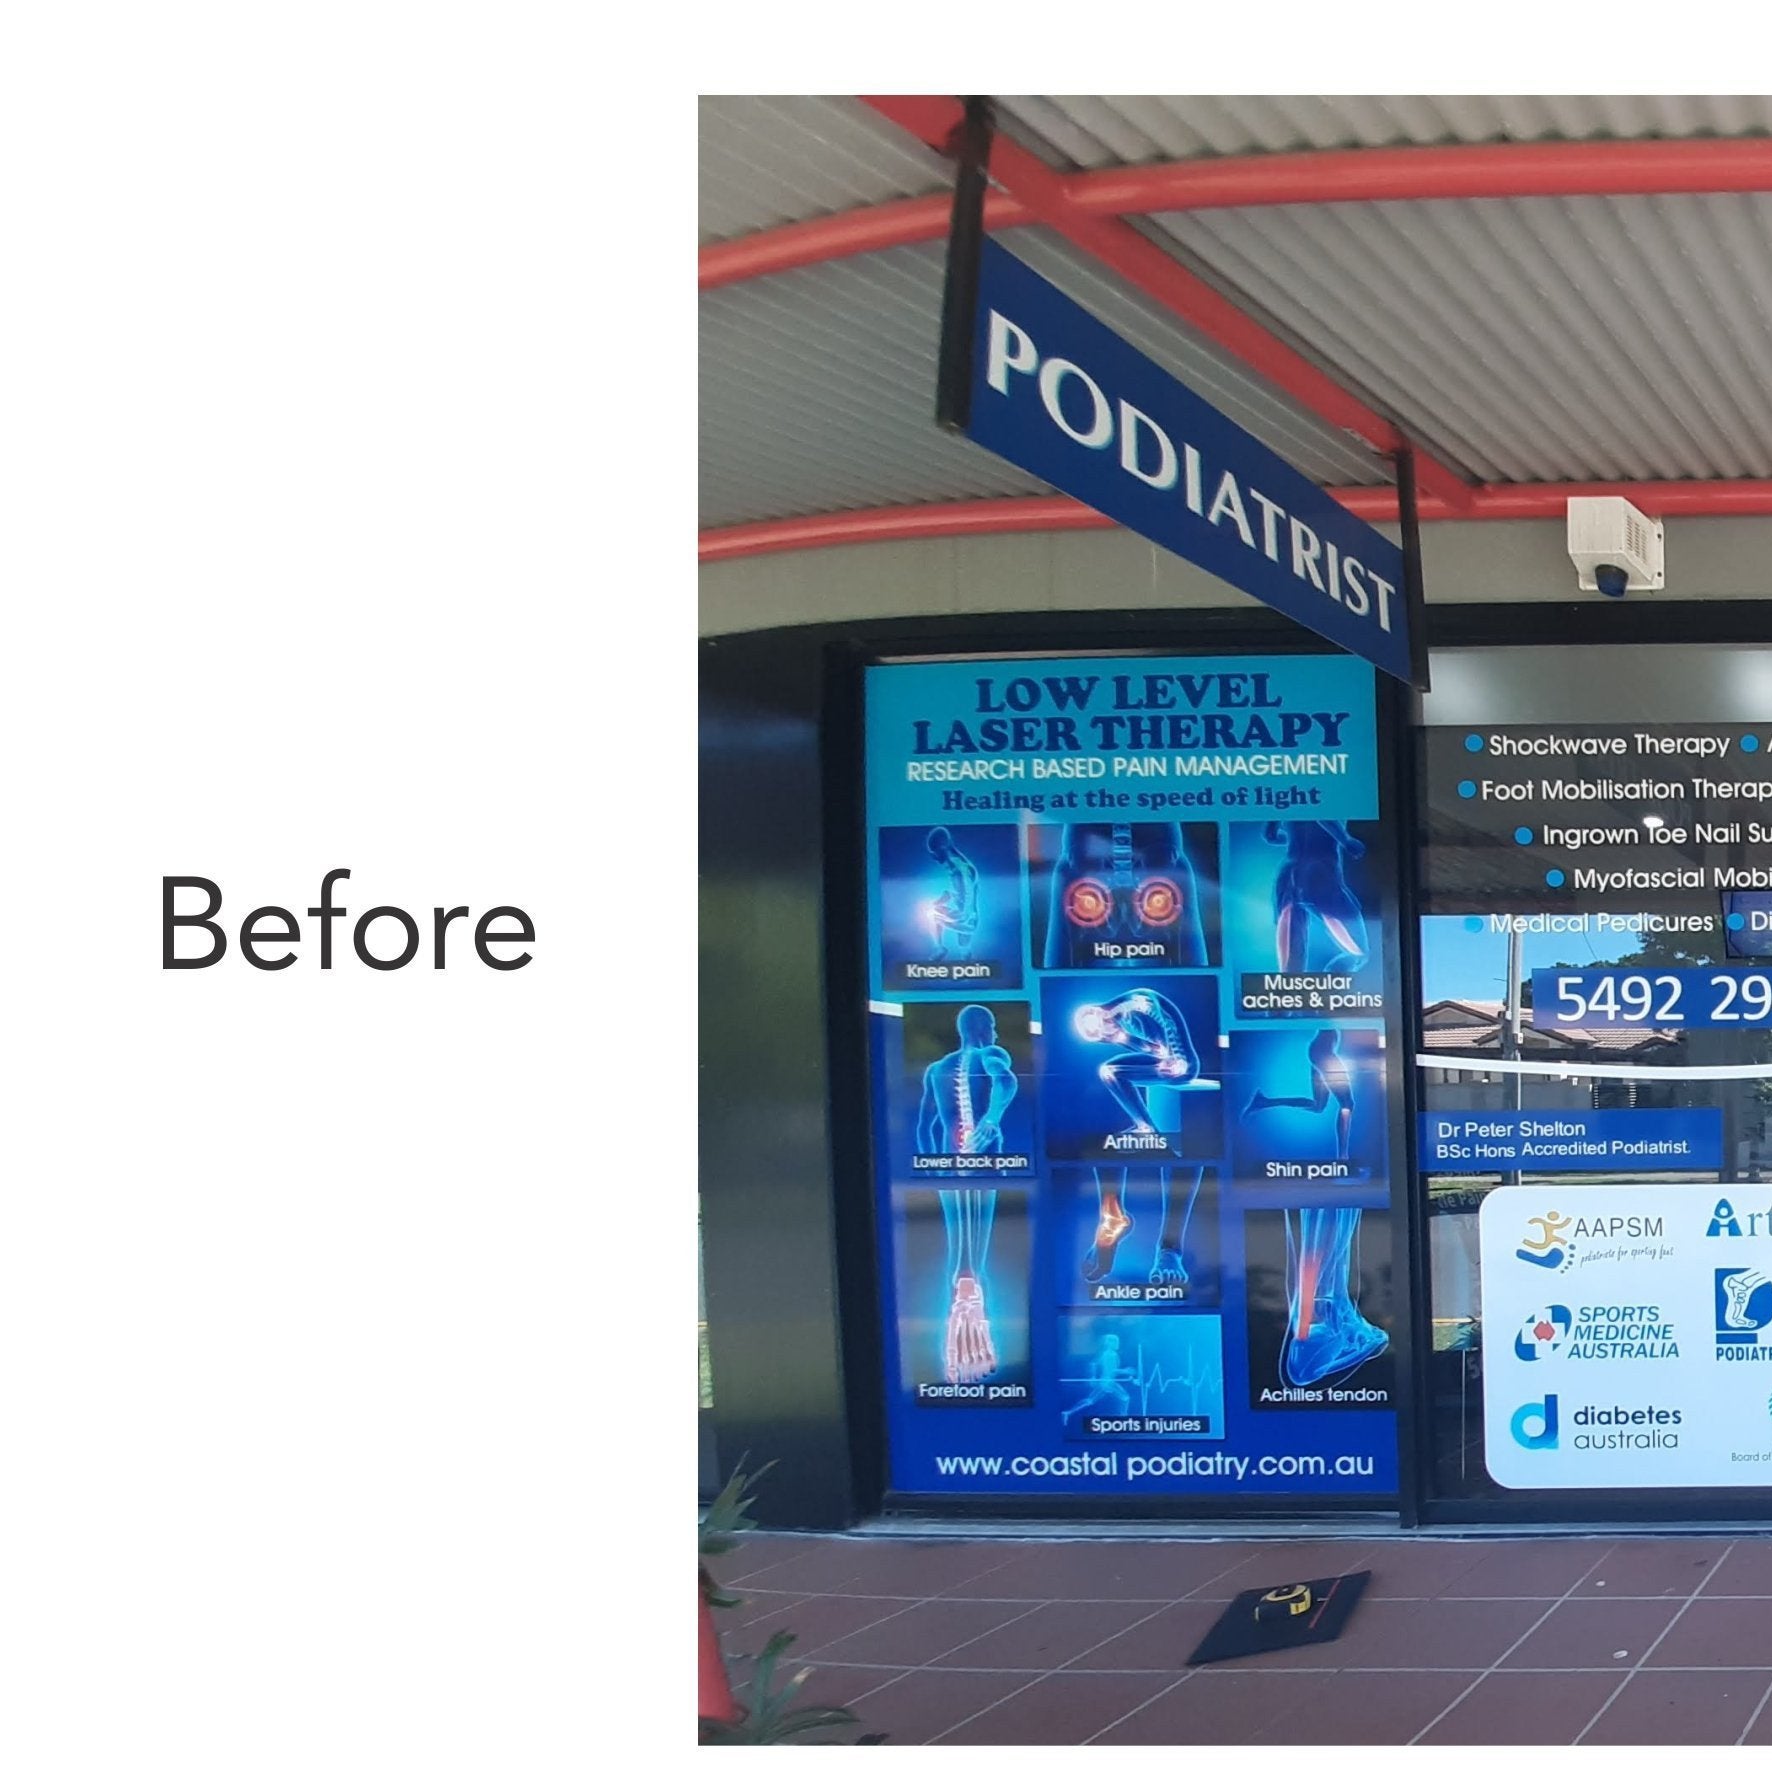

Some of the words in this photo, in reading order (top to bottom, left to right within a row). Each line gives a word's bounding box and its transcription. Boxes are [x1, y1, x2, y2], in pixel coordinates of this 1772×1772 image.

[986, 308, 1396, 634] PODIATRIST
[975, 676, 1106, 712] LOW
[1113, 673, 1282, 709] LEVEL
[912, 716, 1086, 754] LASER
[1090, 712, 1350, 751] THERAPY
[1489, 735, 1627, 756] Shockwave
[1634, 735, 1730, 758] Therapy
[907, 760, 1025, 781] RESEARCH
[1032, 757, 1106, 779] BASED
[1113, 756, 1167, 778] PAIN
[1174, 753, 1348, 776] MANAGEMENT
[1482, 780, 1534, 800] Foot
[1542, 779, 1685, 800] Mobilisation
[942, 790, 1045, 813] Healing
[1052, 791, 1077, 809] at
[1084, 790, 1130, 808] the
[1137, 789, 1212, 811] speed
[1220, 788, 1249, 806] of
[1254, 786, 1320, 809] light
[1543, 825, 1639, 849] Ingrown
[1646, 825, 1687, 844] Toe
[1695, 824, 1740, 843] Nail
[1574, 868, 1705, 892] Myofascial
[1490, 913, 1589, 933] Medical
[1597, 912, 1713, 933] Pedicures
[1094, 941, 1123, 959] Hip
[1126, 942, 1165, 960] pain
[907, 963, 947, 979] Knee
[951, 963, 990, 982] pain
[1264, 974, 1352, 992] Muscular
[1242, 992, 1304, 1009] aches
[1330, 992, 1382, 1011] pains
[1557, 976, 1684, 1022] 5492
[1438, 1122, 1461, 1138] Dr
[1465, 1122, 1514, 1137] Peter
[1520, 1121, 1586, 1136] Shelton
[1104, 1134, 1167, 1151] Arthritis
[1437, 1144, 1471, 1159] BSc
[1475, 1144, 1516, 1158] Hons
[1522, 1140, 1607, 1155] Accredited
[913, 1155, 953, 1169] Lower
[956, 1155, 992, 1169] back
[996, 1155, 1027, 1171] pain
[1266, 1162, 1303, 1178] Shin
[1307, 1162, 1348, 1180] pain
[1574, 1217, 1663, 1238] AAPSM
[1096, 1285, 1140, 1300] Ankle
[1145, 1285, 1183, 1302] pain
[1578, 1306, 1660, 1322] SPORTS
[1574, 1324, 1674, 1341] MEDICINE
[1568, 1342, 1680, 1359] AUSTRALIA
[919, 1383, 985, 1399] Forefoot
[990, 1383, 1026, 1401] pain
[1260, 1387, 1323, 1403] Achilles
[1328, 1387, 1387, 1403] tendon
[1091, 1417, 1140, 1434] Sports
[1144, 1417, 1201, 1433] injuries
[1573, 1406, 1682, 1426] diabetes
[1573, 1428, 1679, 1450] australia
[936, 1452, 1117, 1477] www.coastal
[1127, 1451, 1374, 1480] podiatry.com.au
[1731, 1453, 1759, 1462] Board
[1762, 1452, 1771, 1461] of
